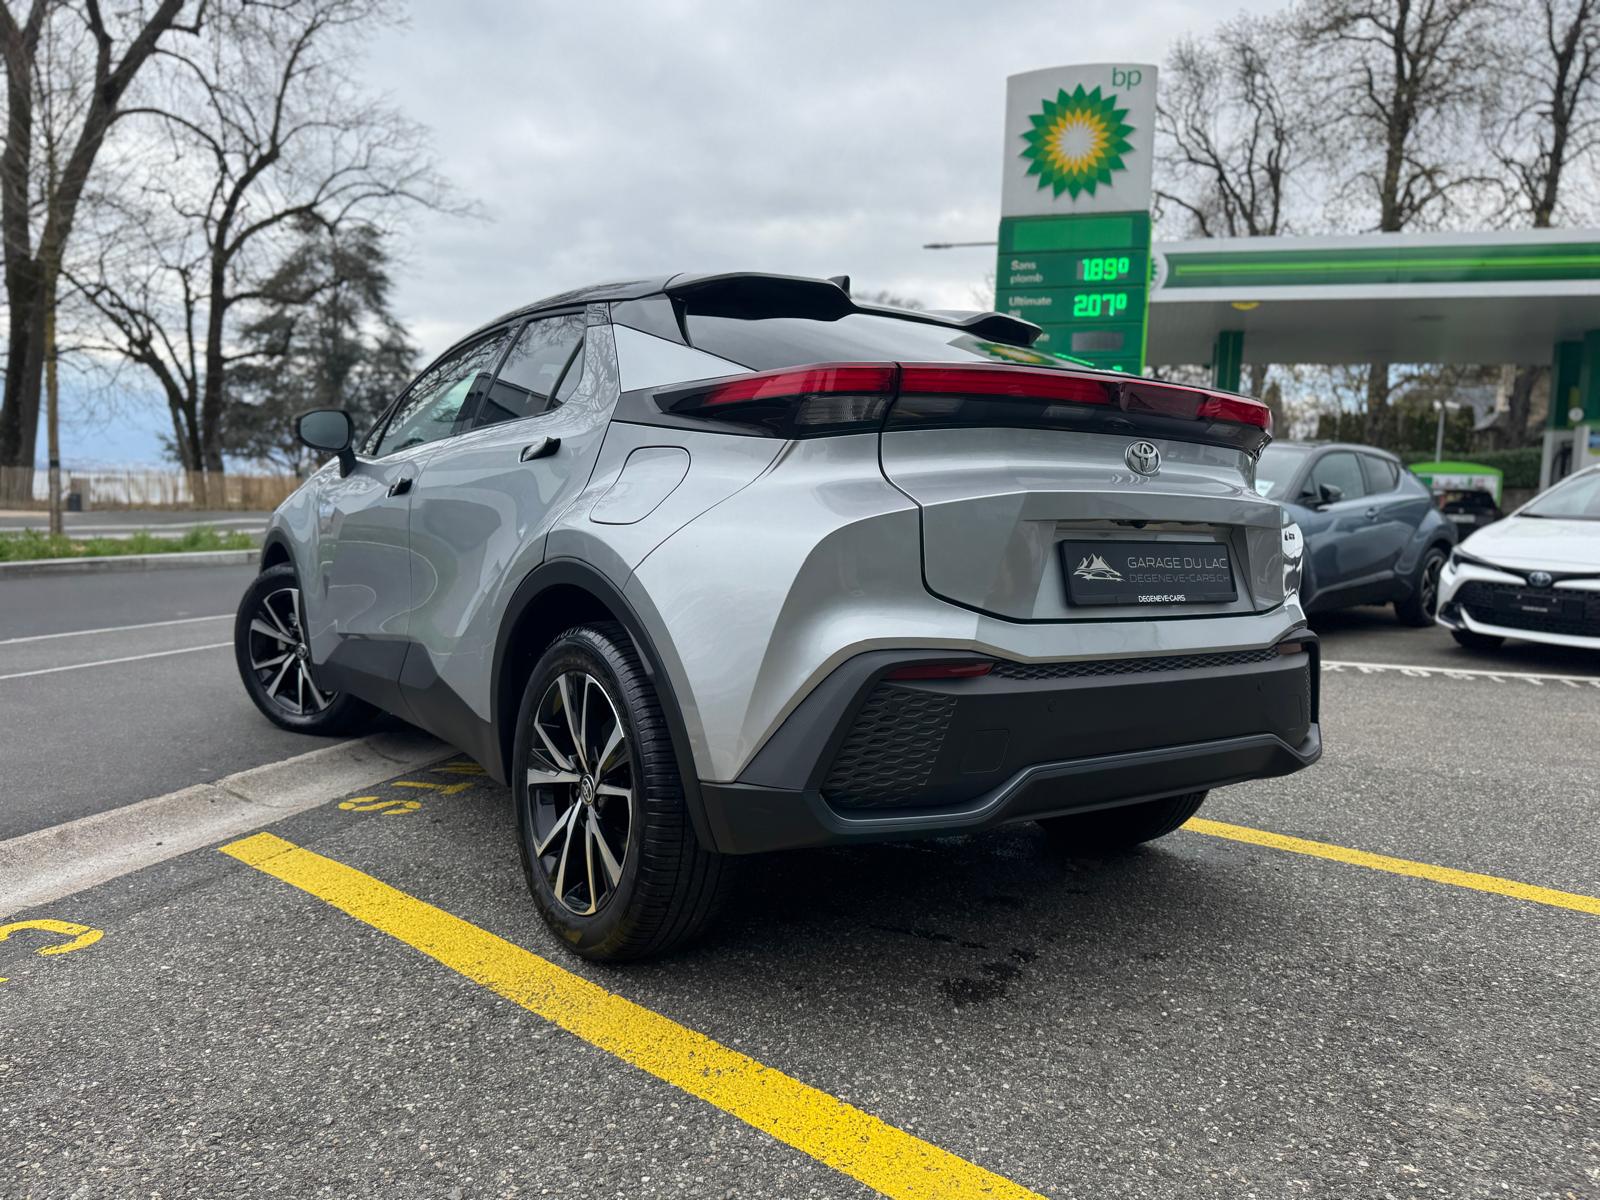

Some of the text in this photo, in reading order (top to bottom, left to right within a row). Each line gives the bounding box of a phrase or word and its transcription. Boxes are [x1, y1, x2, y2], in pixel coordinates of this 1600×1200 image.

[1112, 67, 1142, 91] bp
[1011, 260, 1037, 271] Sans
[1010, 273, 1043, 284] plomb
[1008, 296, 1052, 306] Ultimate
[1127, 557, 1228, 569] GARAGE DU LAC
[1138, 594, 1186, 603] DEGENEVE-CARS
